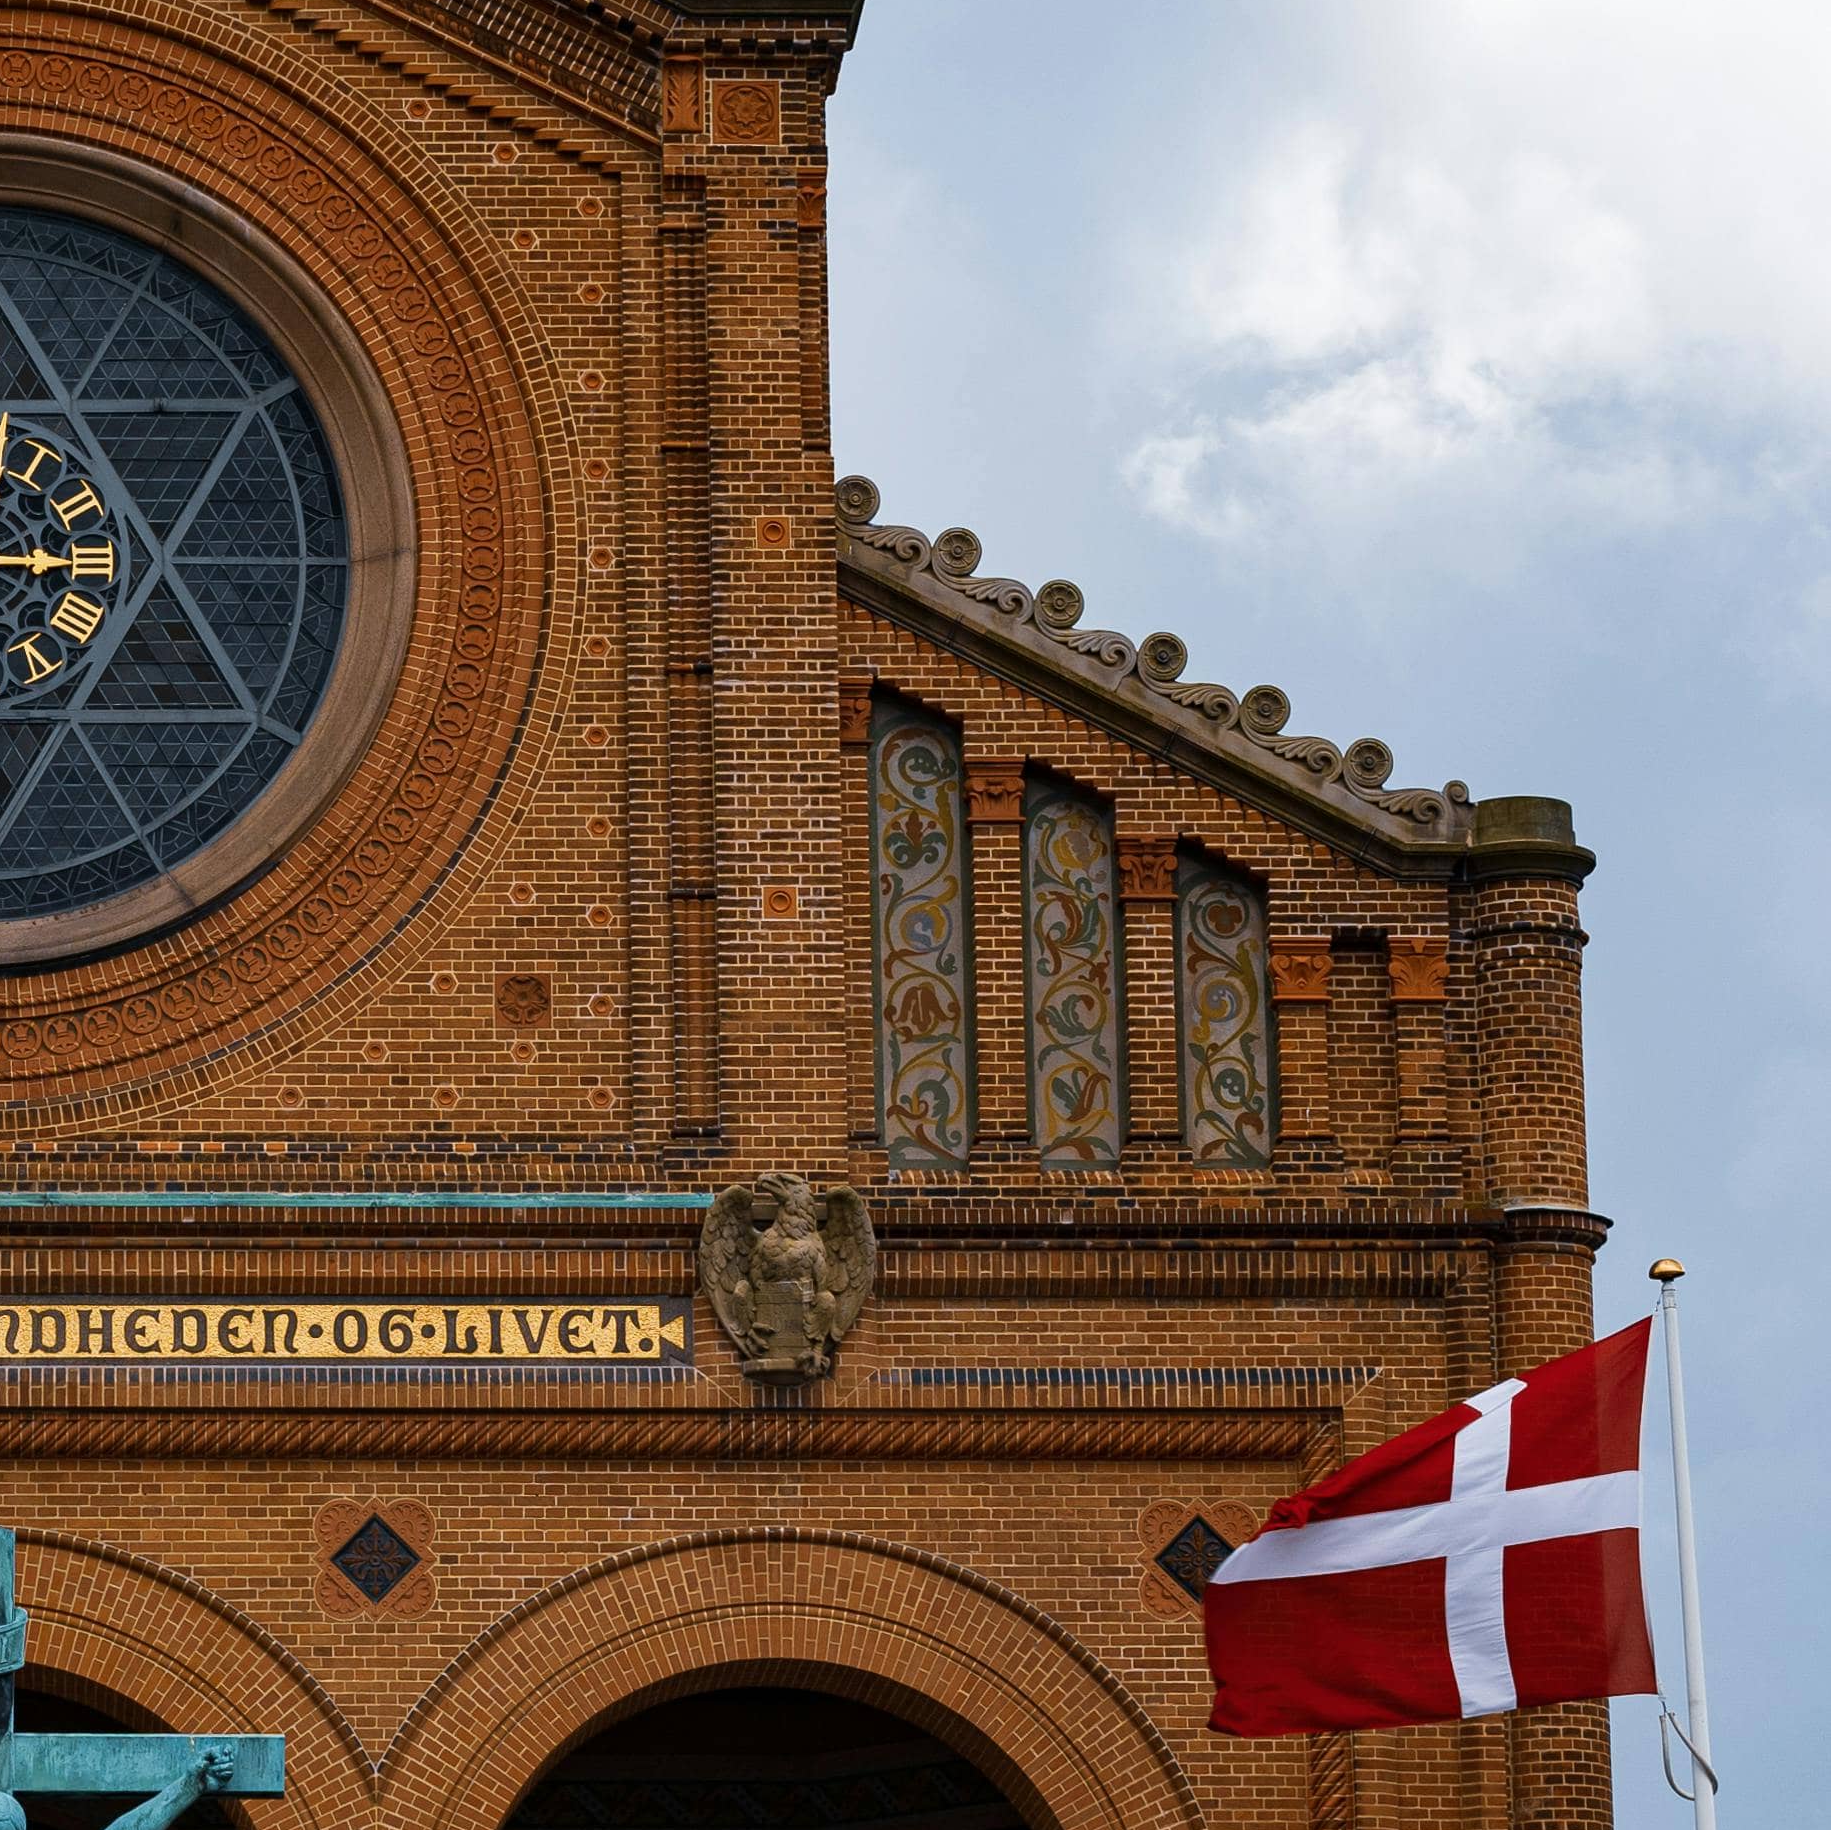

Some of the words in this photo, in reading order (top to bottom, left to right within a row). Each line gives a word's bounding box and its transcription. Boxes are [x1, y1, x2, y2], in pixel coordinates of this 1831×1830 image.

[50, 480, 104, 531] II
[71, 540, 114, 583] III
[50, 592, 104, 644] IIII
[8, 633, 63, 684] V
